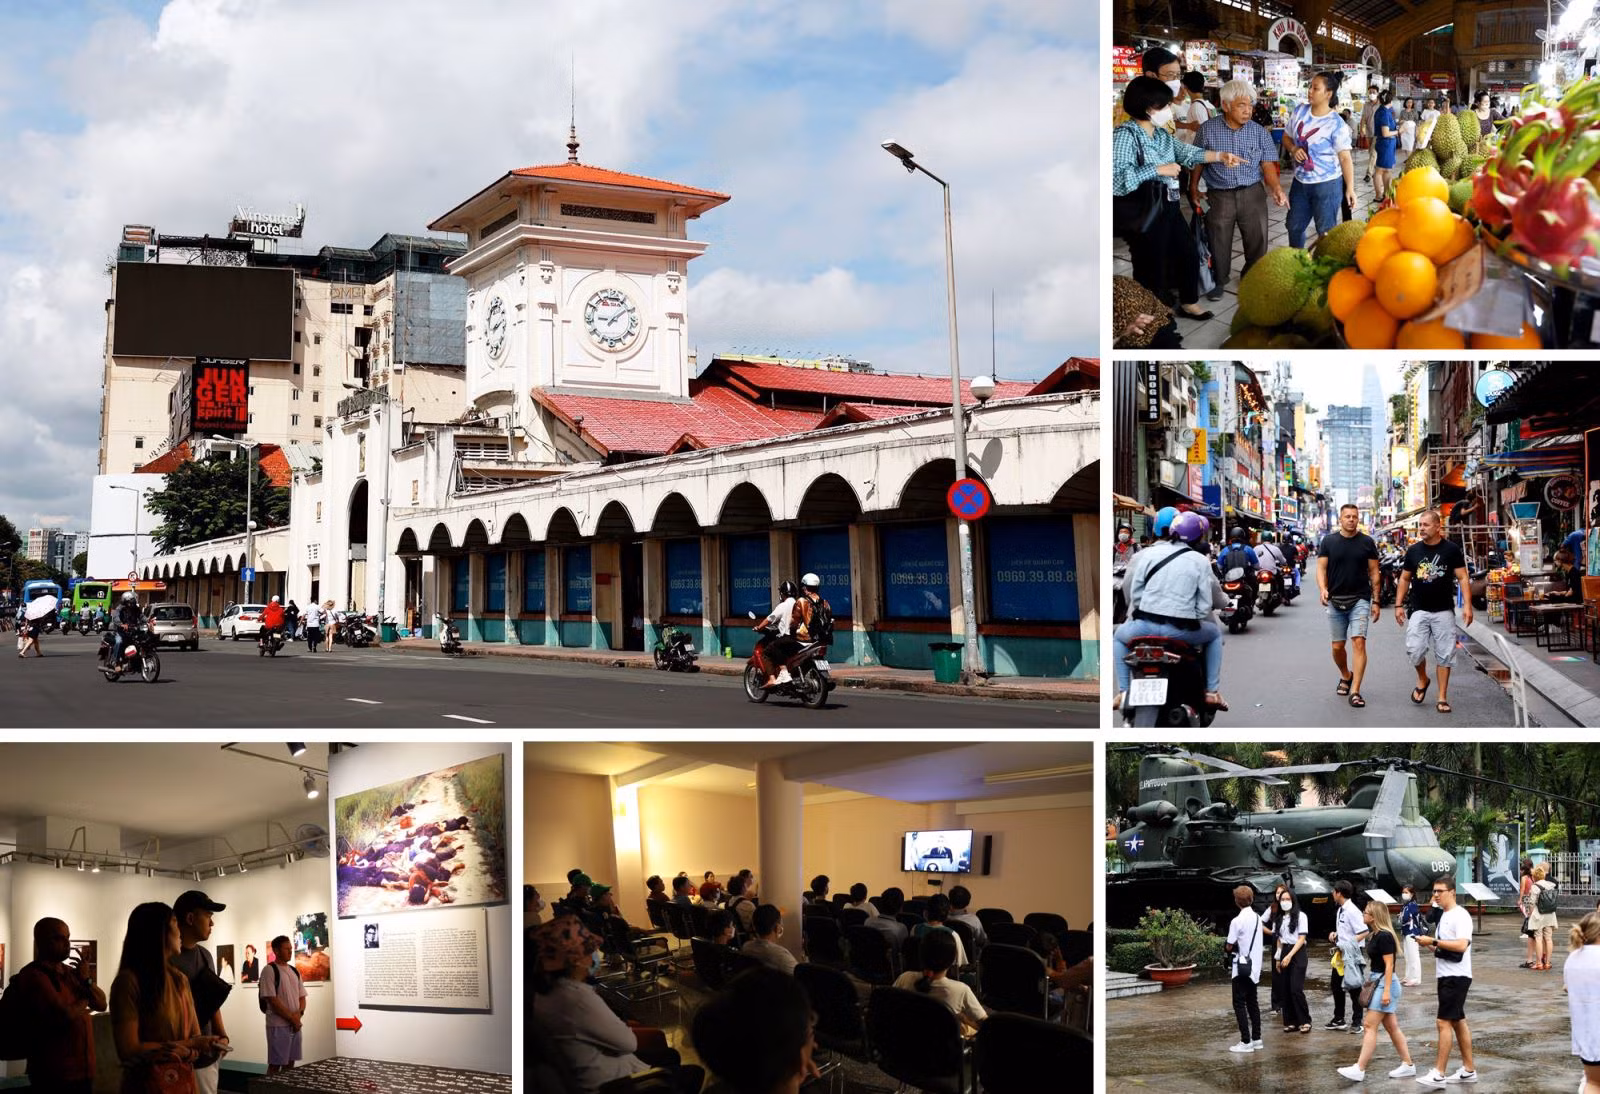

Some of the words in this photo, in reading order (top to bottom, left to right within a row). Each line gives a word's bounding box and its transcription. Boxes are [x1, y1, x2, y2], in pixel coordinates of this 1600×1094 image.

[250, 222, 284, 236] hotel
[197, 367, 245, 386] JUN
[1148, 374, 1157, 396] DOG
[196, 383, 247, 403] GER
[1149, 398, 1158, 419] BAR
[1431, 860, 1451, 873] 086
